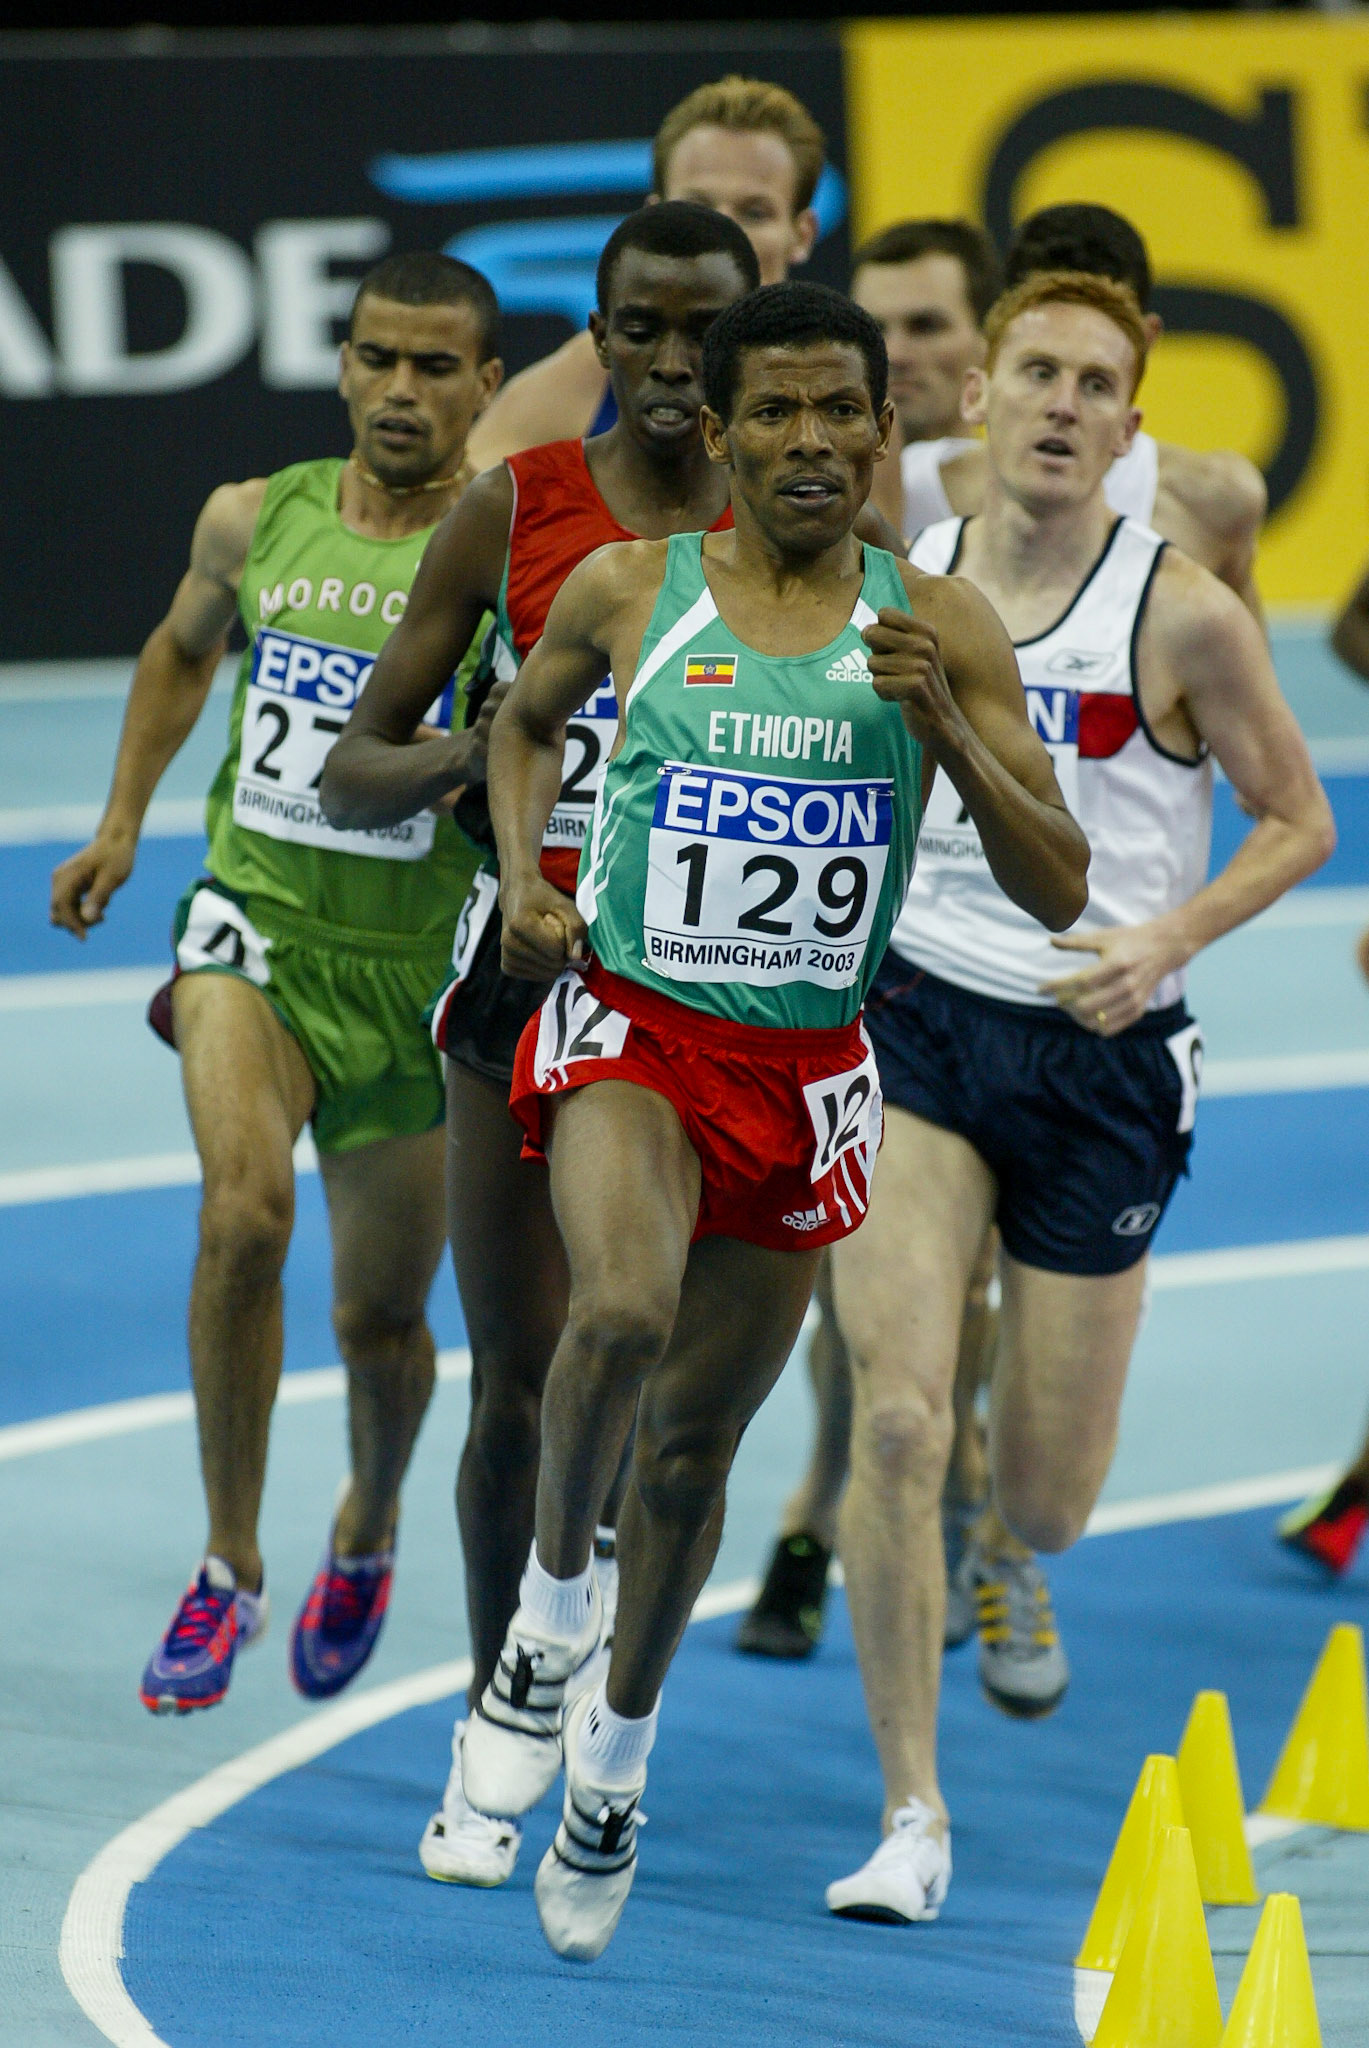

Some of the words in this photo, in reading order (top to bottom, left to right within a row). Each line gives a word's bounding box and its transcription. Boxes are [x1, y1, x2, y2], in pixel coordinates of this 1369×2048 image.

[707, 710, 853, 764] ETHIOPIA
[663, 776, 878, 845] EPSON
[676, 842, 869, 938] 129
[650, 936, 802, 970] BIRMINGHAM
[807, 949, 856, 973] 2003
[553, 981, 614, 1062] 12
[819, 1074, 871, 1167] 12
